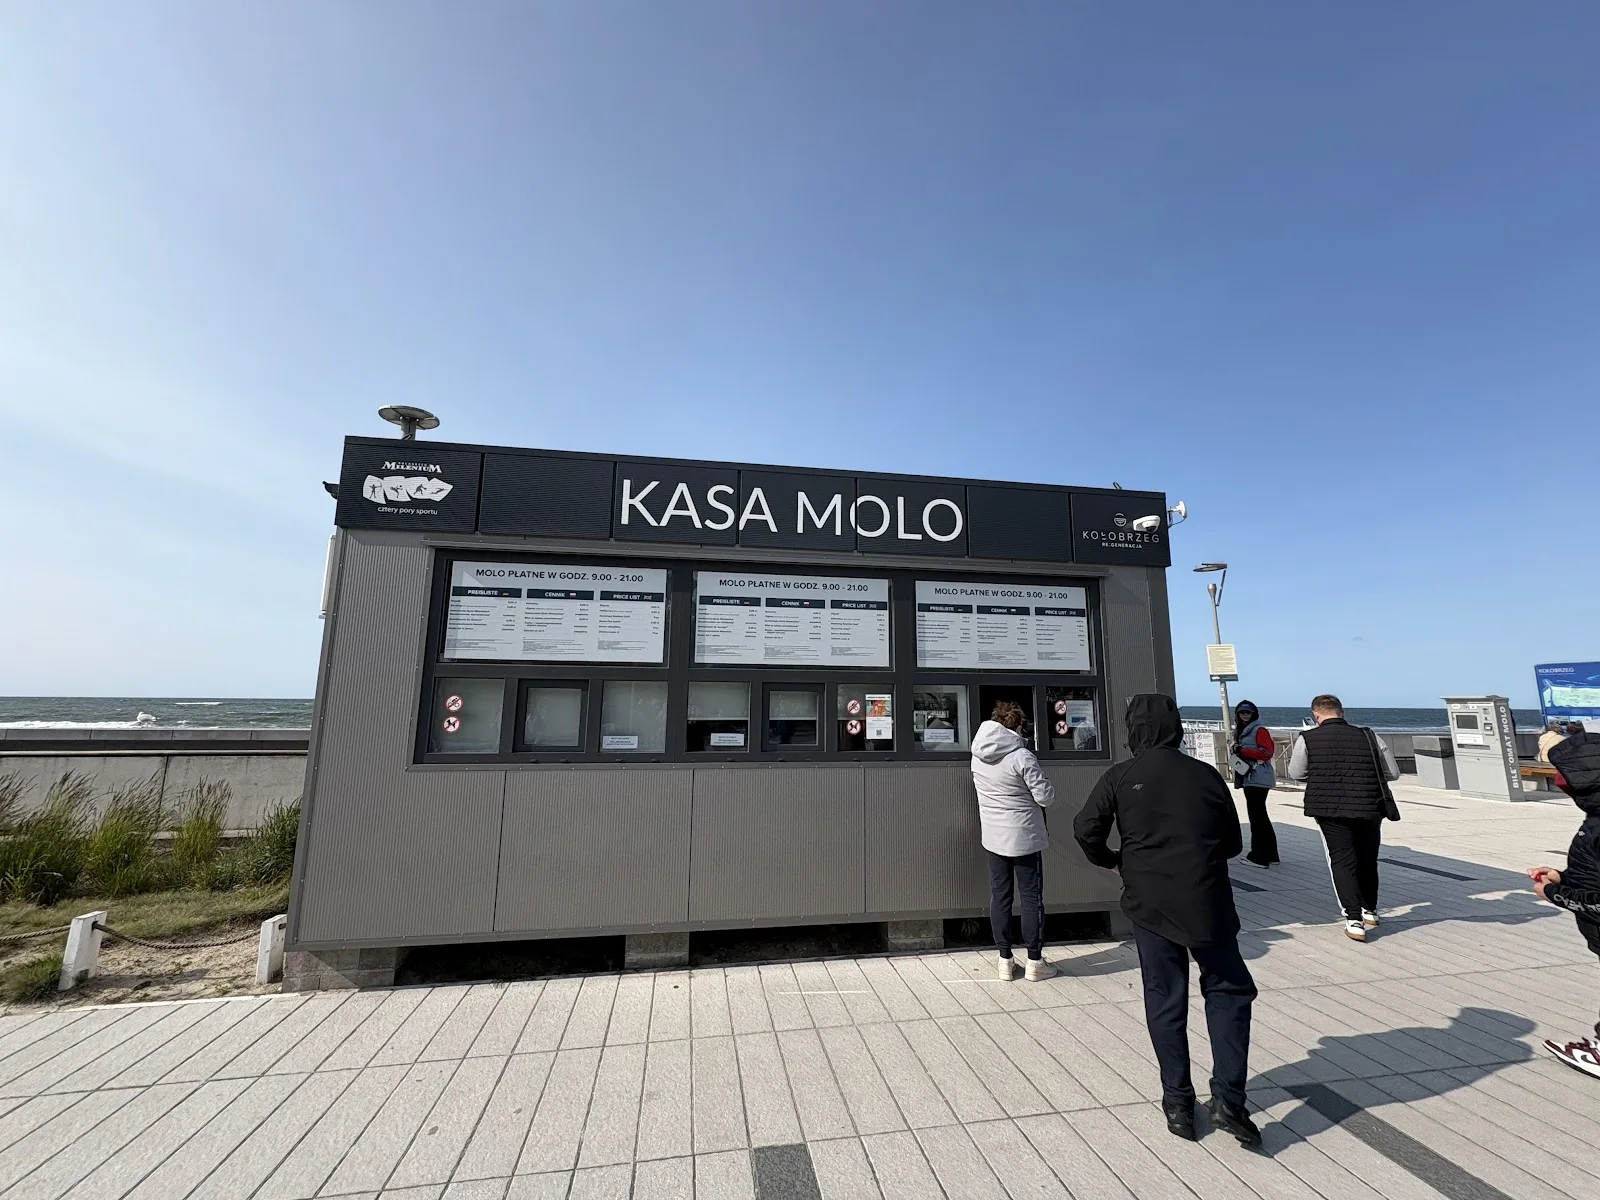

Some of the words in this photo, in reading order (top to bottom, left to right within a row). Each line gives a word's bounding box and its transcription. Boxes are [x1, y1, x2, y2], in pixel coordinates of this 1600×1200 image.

[399, 507, 416, 515] pory
[620, 479, 778, 533] KASA
[797, 491, 963, 542] MOLO
[476, 569, 505, 577] MOLO
[508, 570, 545, 579] PŁATNE
[547, 571, 557, 580] W
[559, 572, 589, 580] GODZ.
[591, 573, 612, 581] 9.00
[619, 574, 644, 582] 21.00
[719, 579, 746, 587] MOLO
[748, 580, 781, 588] PŁATNE
[793, 582, 820, 590] GODZ.
[822, 583, 840, 591] 9.00
[1001, 590, 1024, 598] GODZ.
[1500, 706, 1511, 733] MOLO
